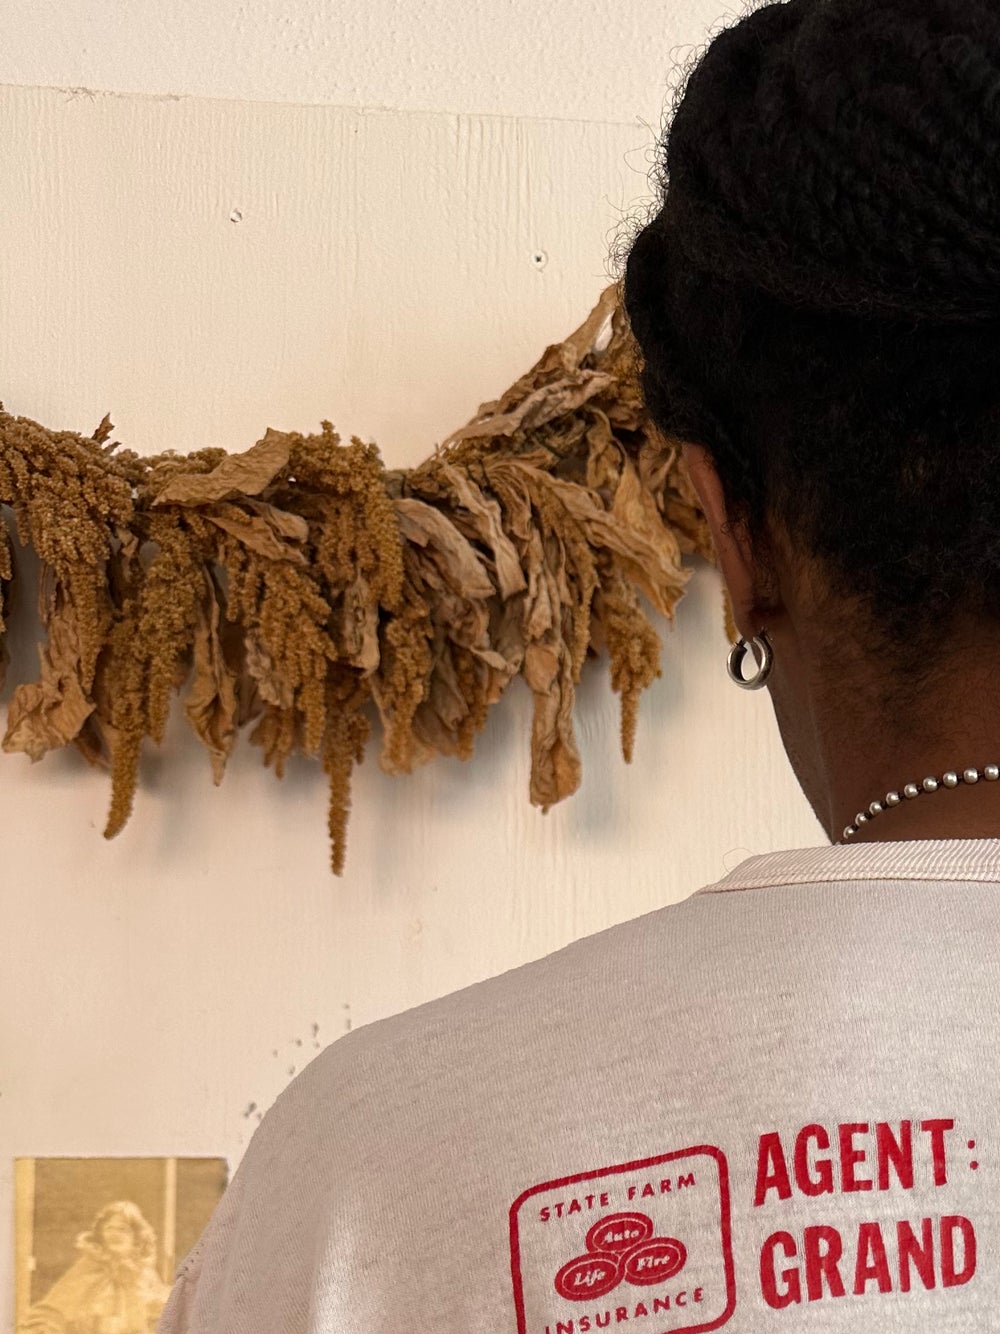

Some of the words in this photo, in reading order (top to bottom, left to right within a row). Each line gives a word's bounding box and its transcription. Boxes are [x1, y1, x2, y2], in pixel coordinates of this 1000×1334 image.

[753, 1117, 980, 1208] AGENT:
[539, 1192, 610, 1223] STATE
[627, 1172, 697, 1201] FARM
[602, 1228, 641, 1245] Auto
[635, 1254, 672, 1272] Fire
[758, 1212, 978, 1310] GRAND
[572, 1270, 608, 1288] Life
